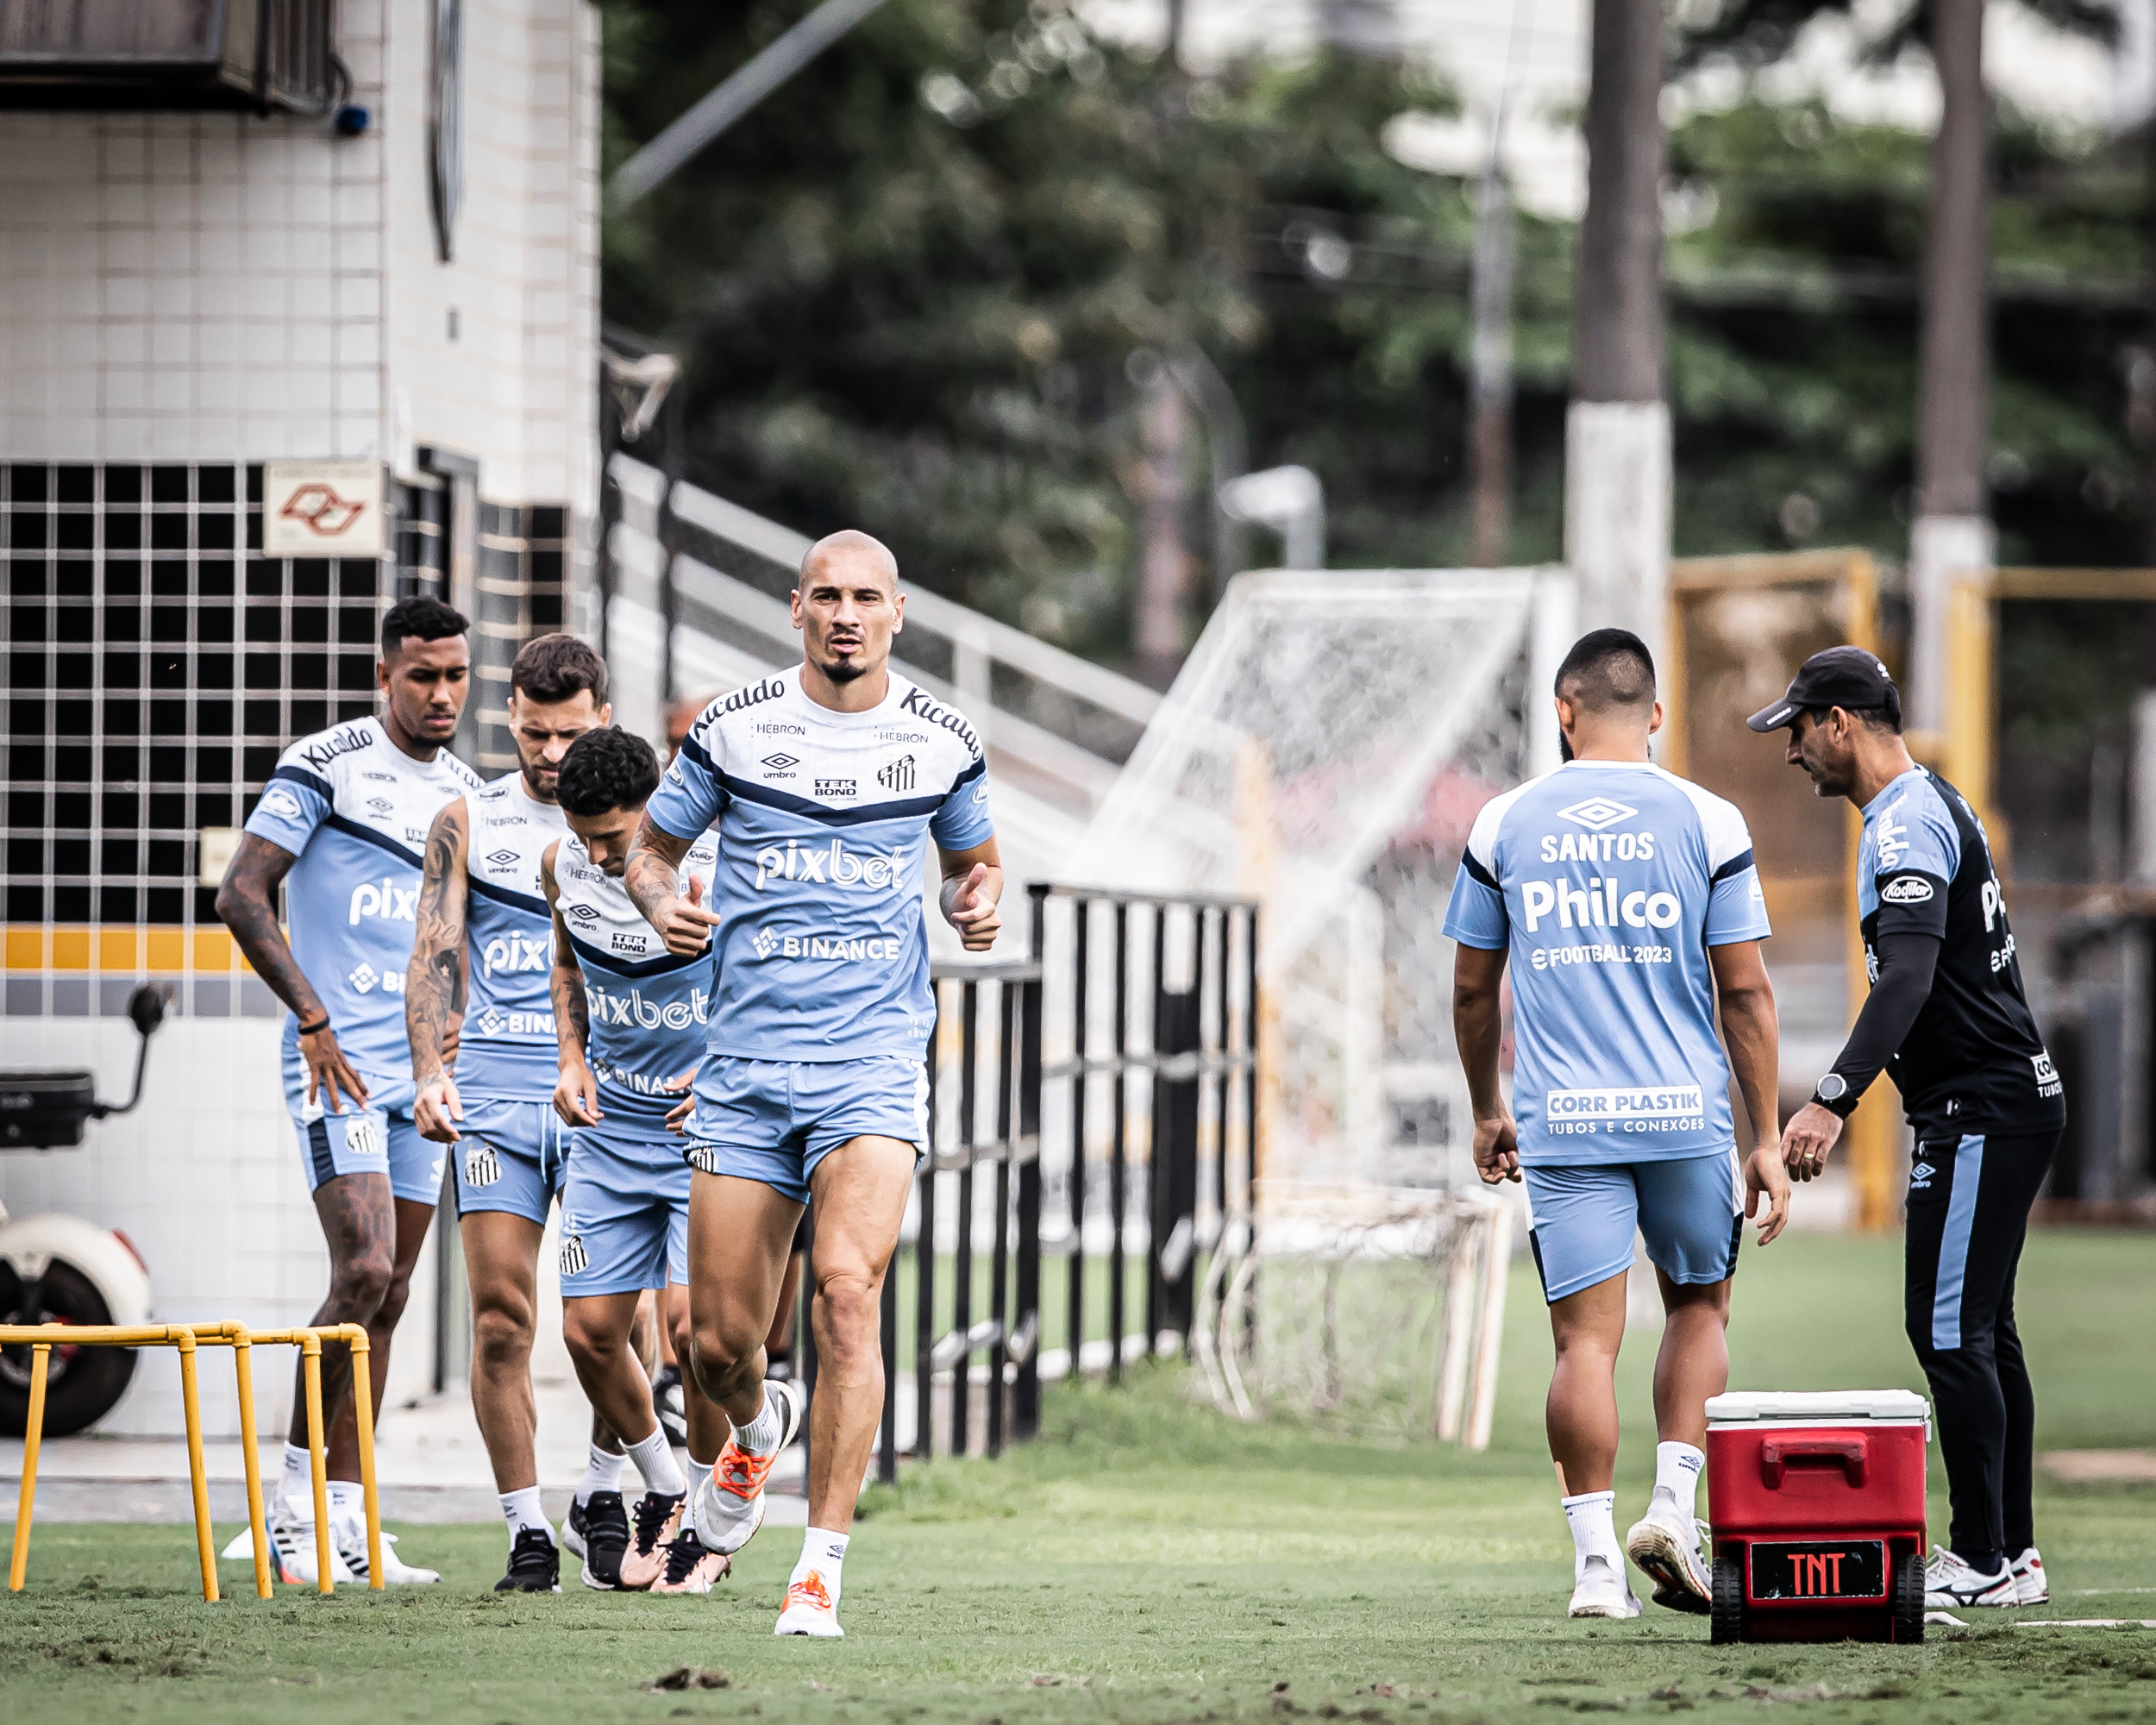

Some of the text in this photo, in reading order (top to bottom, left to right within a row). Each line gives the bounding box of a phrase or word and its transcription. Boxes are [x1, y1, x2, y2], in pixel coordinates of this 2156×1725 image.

[694, 679, 785, 741] Kicaldo
[756, 723, 805, 736] HEBRON
[880, 731, 929, 743] HEBRON
[815, 779, 856, 787] TEK
[1540, 831, 1655, 863] SANTOS
[755, 839, 906, 890] pixbet
[1521, 877, 1681, 933] Philco
[611, 942, 646, 952] BOND
[783, 936, 899, 960] BINANCE
[1633, 945, 1672, 964] 2023
[1550, 1092, 1700, 1113] CORR PLASTIK
[1547, 1121, 1596, 1135] TUBOS
[1607, 1121, 1614, 1133] E
[1787, 1553, 1845, 1595] TNT
